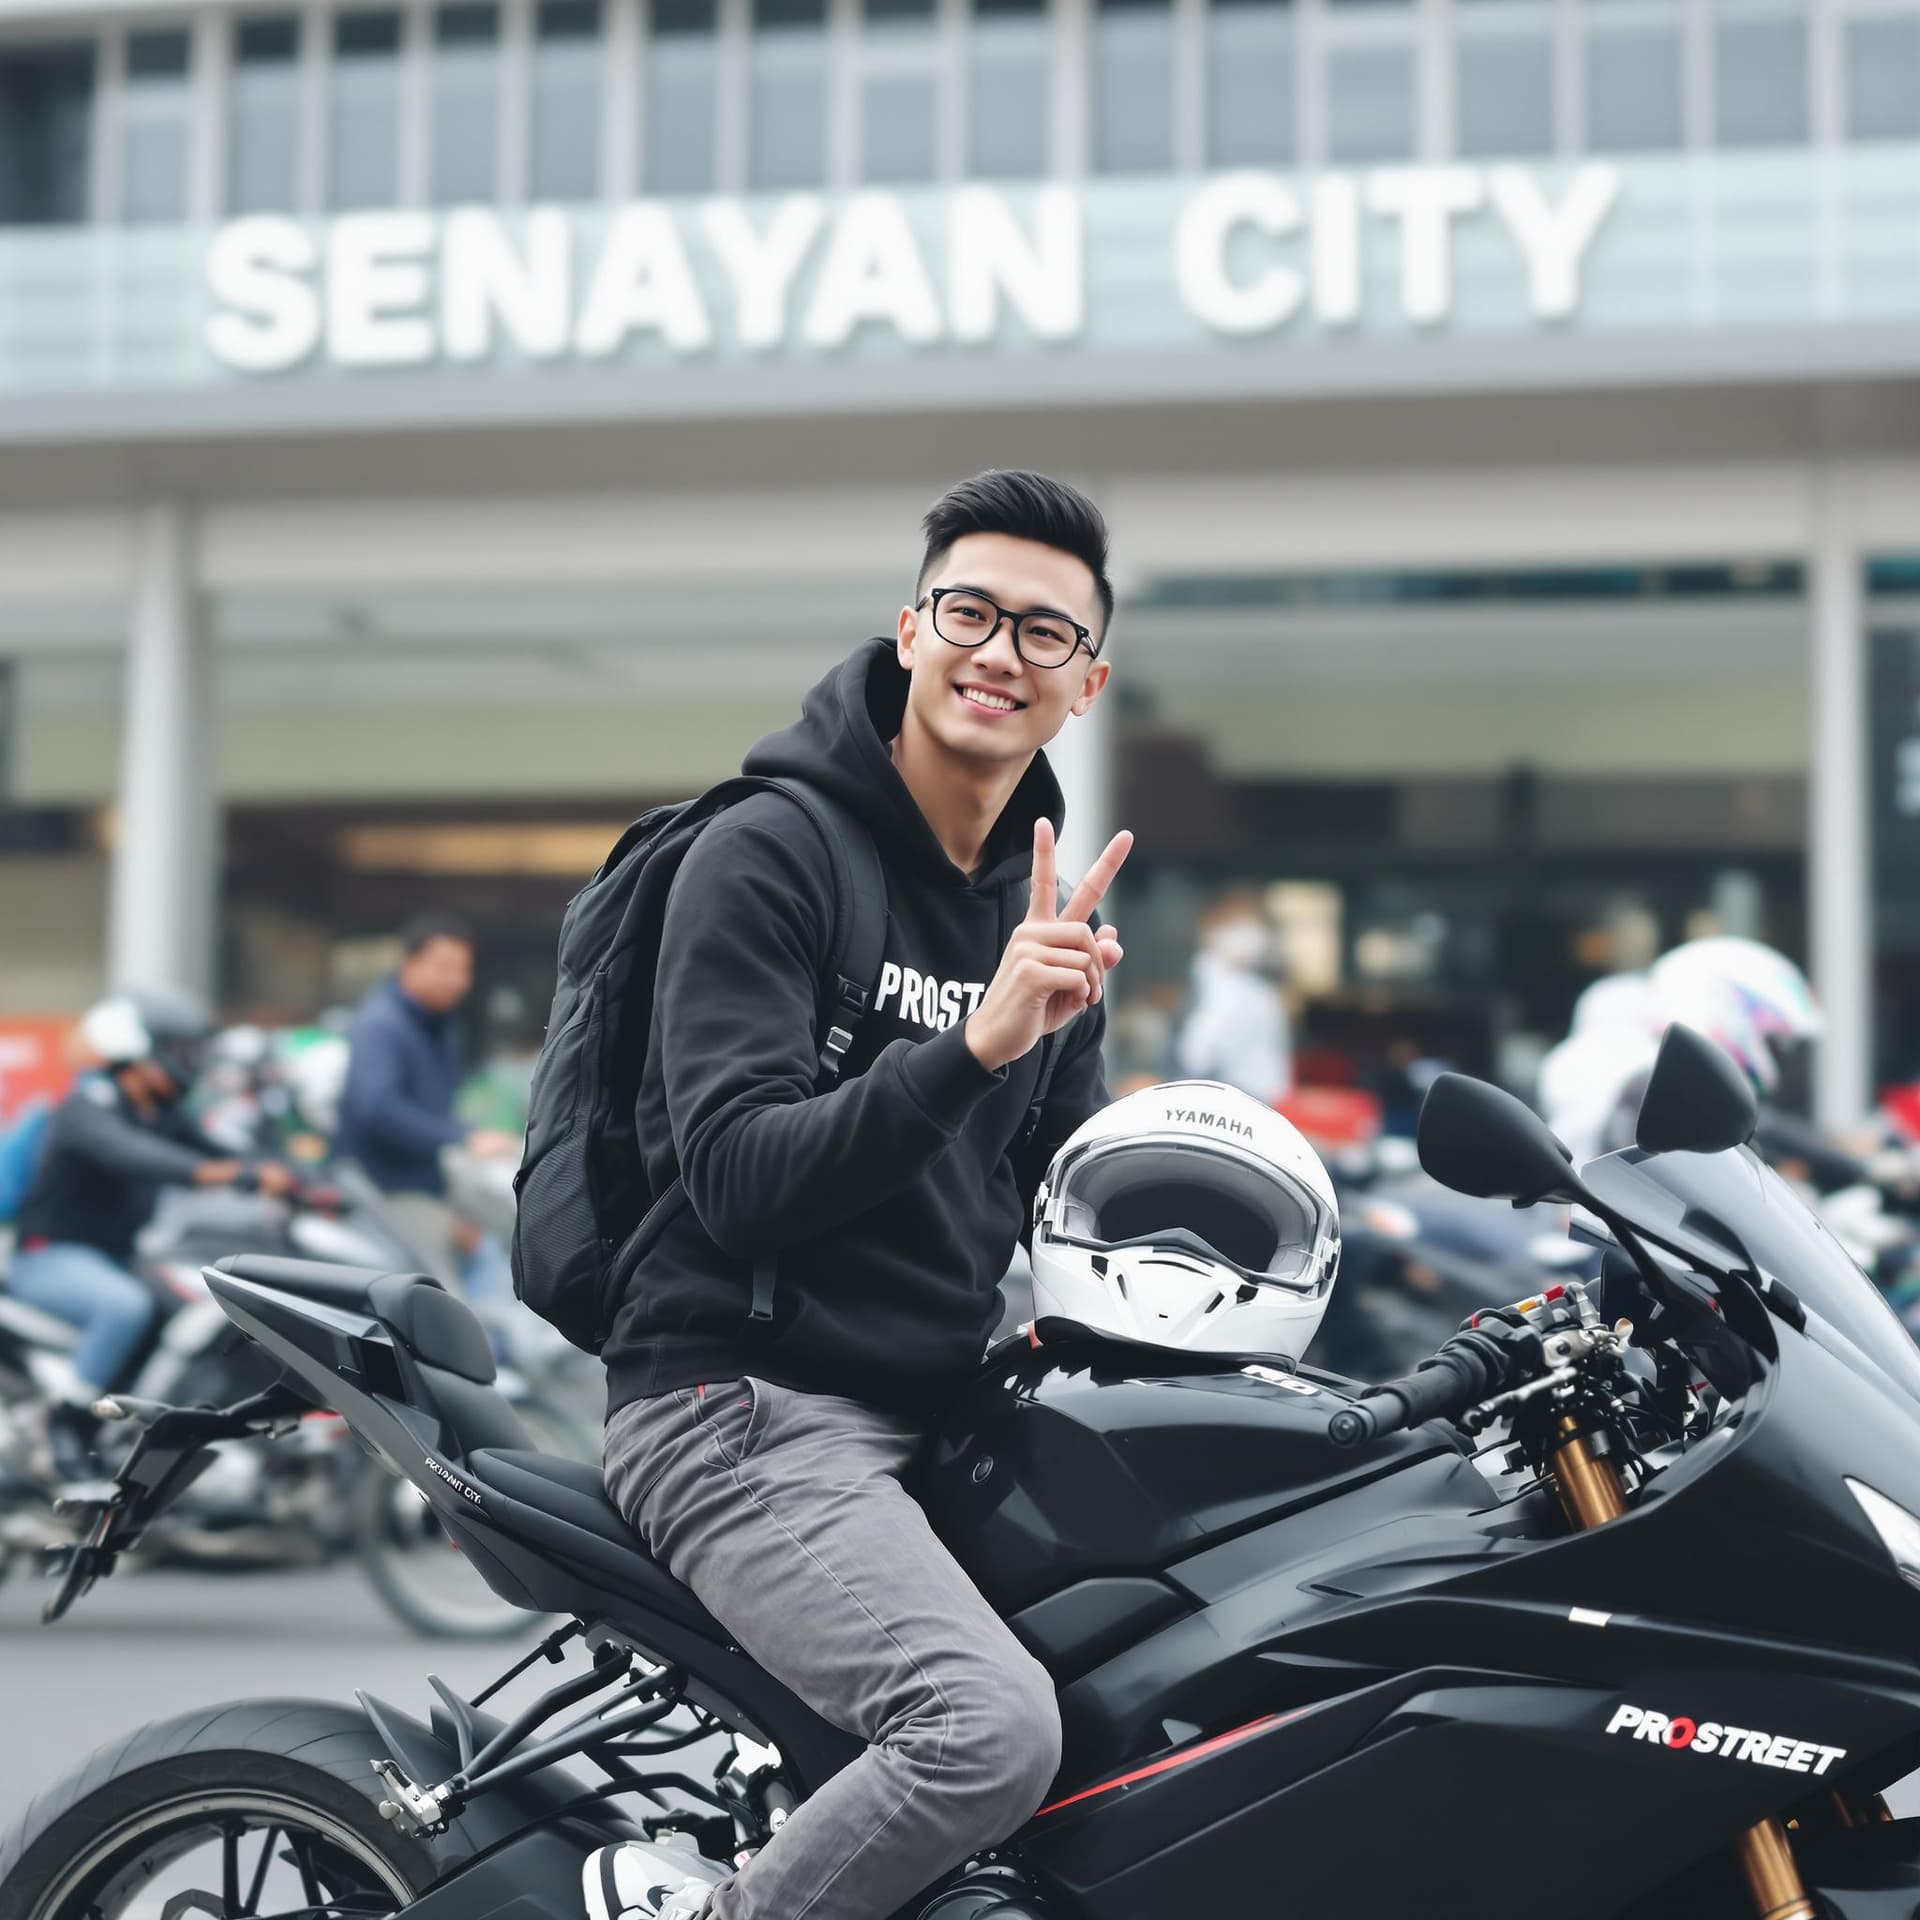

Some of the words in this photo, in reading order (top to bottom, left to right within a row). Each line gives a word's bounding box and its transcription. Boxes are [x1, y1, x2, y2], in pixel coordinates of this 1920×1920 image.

[204, 185, 1083, 372] SENAYAN
[1177, 163, 1620, 333] CITY
[1605, 1704, 1847, 1775] PROSTREET
